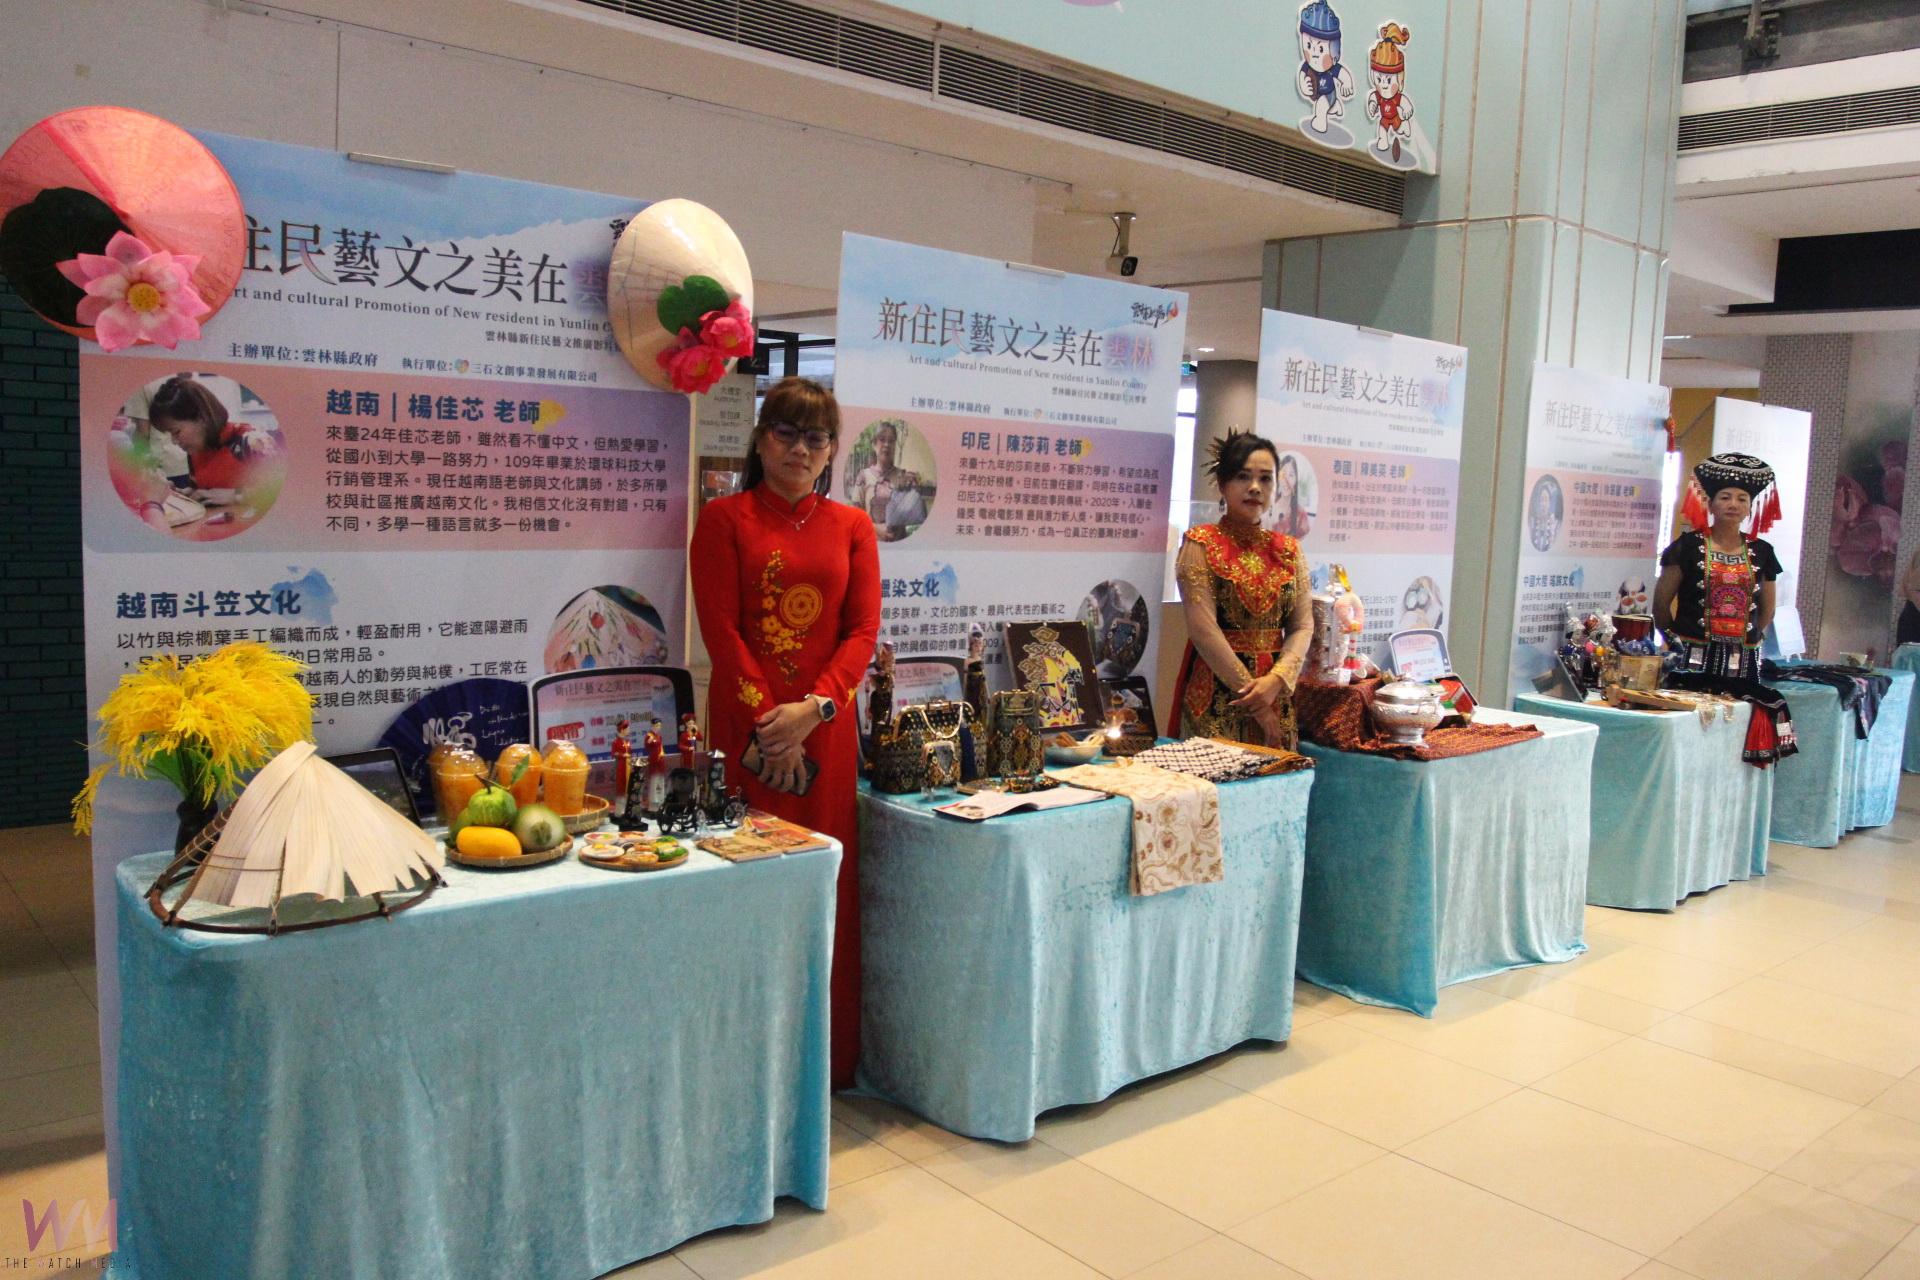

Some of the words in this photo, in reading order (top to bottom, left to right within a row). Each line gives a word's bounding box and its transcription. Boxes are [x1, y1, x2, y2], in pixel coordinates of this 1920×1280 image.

[229, 287, 247, 299] rt
[253, 289, 282, 301] and
[287, 292, 349, 308] cultural
[355, 298, 430, 315] Promotion
[435, 305, 449, 317] of
[453, 306, 480, 320] New
[486, 310, 538, 326] resident
[544, 316, 555, 327] in
[560, 317, 599, 332] Yunlin
[873, 297, 1153, 370] 新住民藝文之美在雲林
[909, 355, 922, 365] Art
[924, 358, 940, 367] and
[943, 359, 977, 371] cultural
[980, 362, 1022, 377] Promotion
[1052, 371, 1083, 383] resident
[326, 389, 379, 416] 越南
[408, 394, 484, 421] 楊佳芯
[494, 399, 541, 424] 老師
[961, 431, 990, 450] 印尼
[1055, 438, 1082, 456] 老師
[116, 589, 301, 618] 越南斗笠文化
